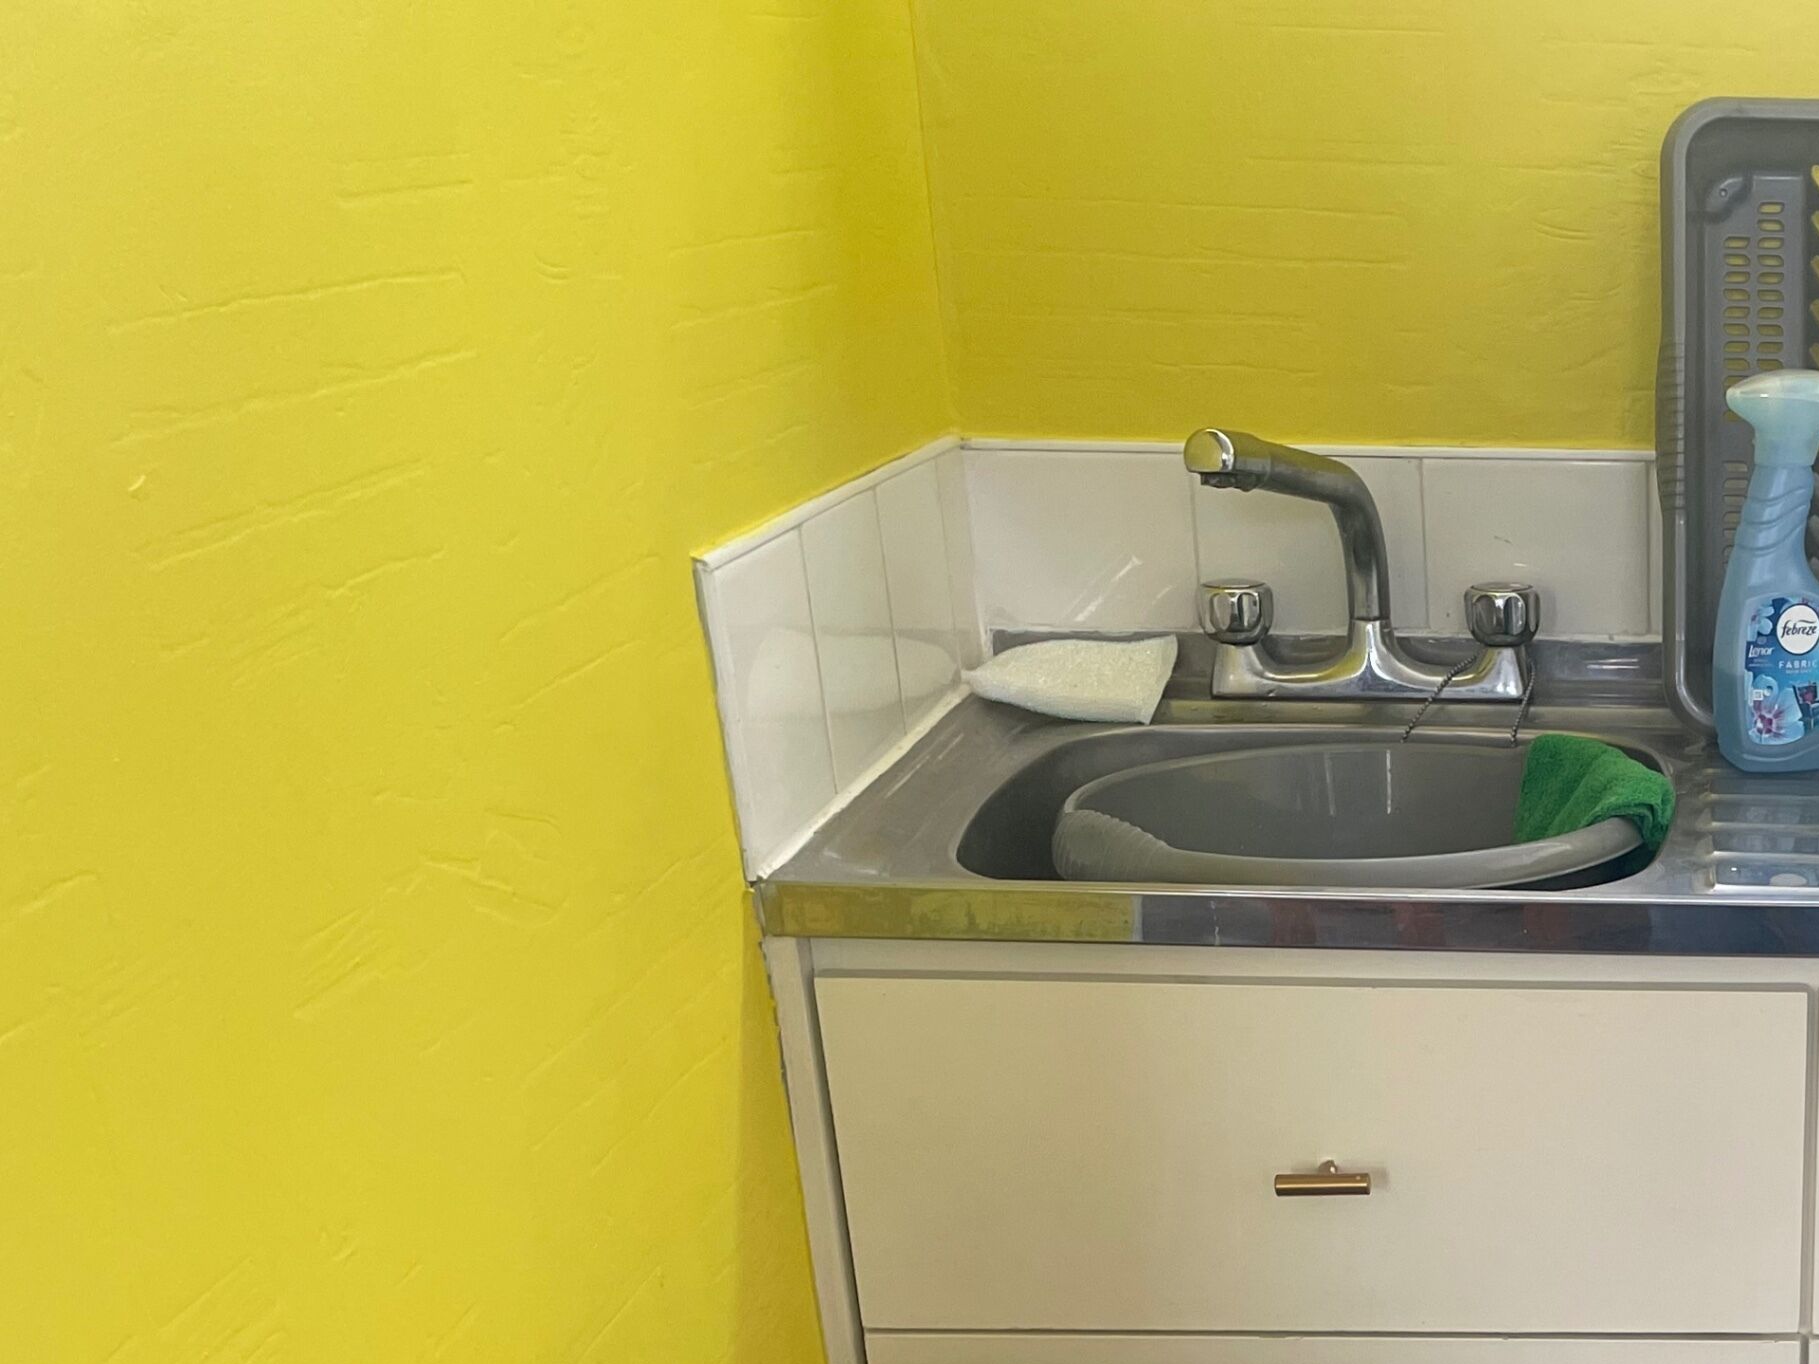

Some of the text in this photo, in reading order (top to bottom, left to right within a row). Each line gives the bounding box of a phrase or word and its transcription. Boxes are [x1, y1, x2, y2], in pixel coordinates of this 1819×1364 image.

[1781, 619, 1818, 638] febreze
[1749, 645, 1774, 658] Lenor
[1779, 660, 1818, 669] FABRIC
